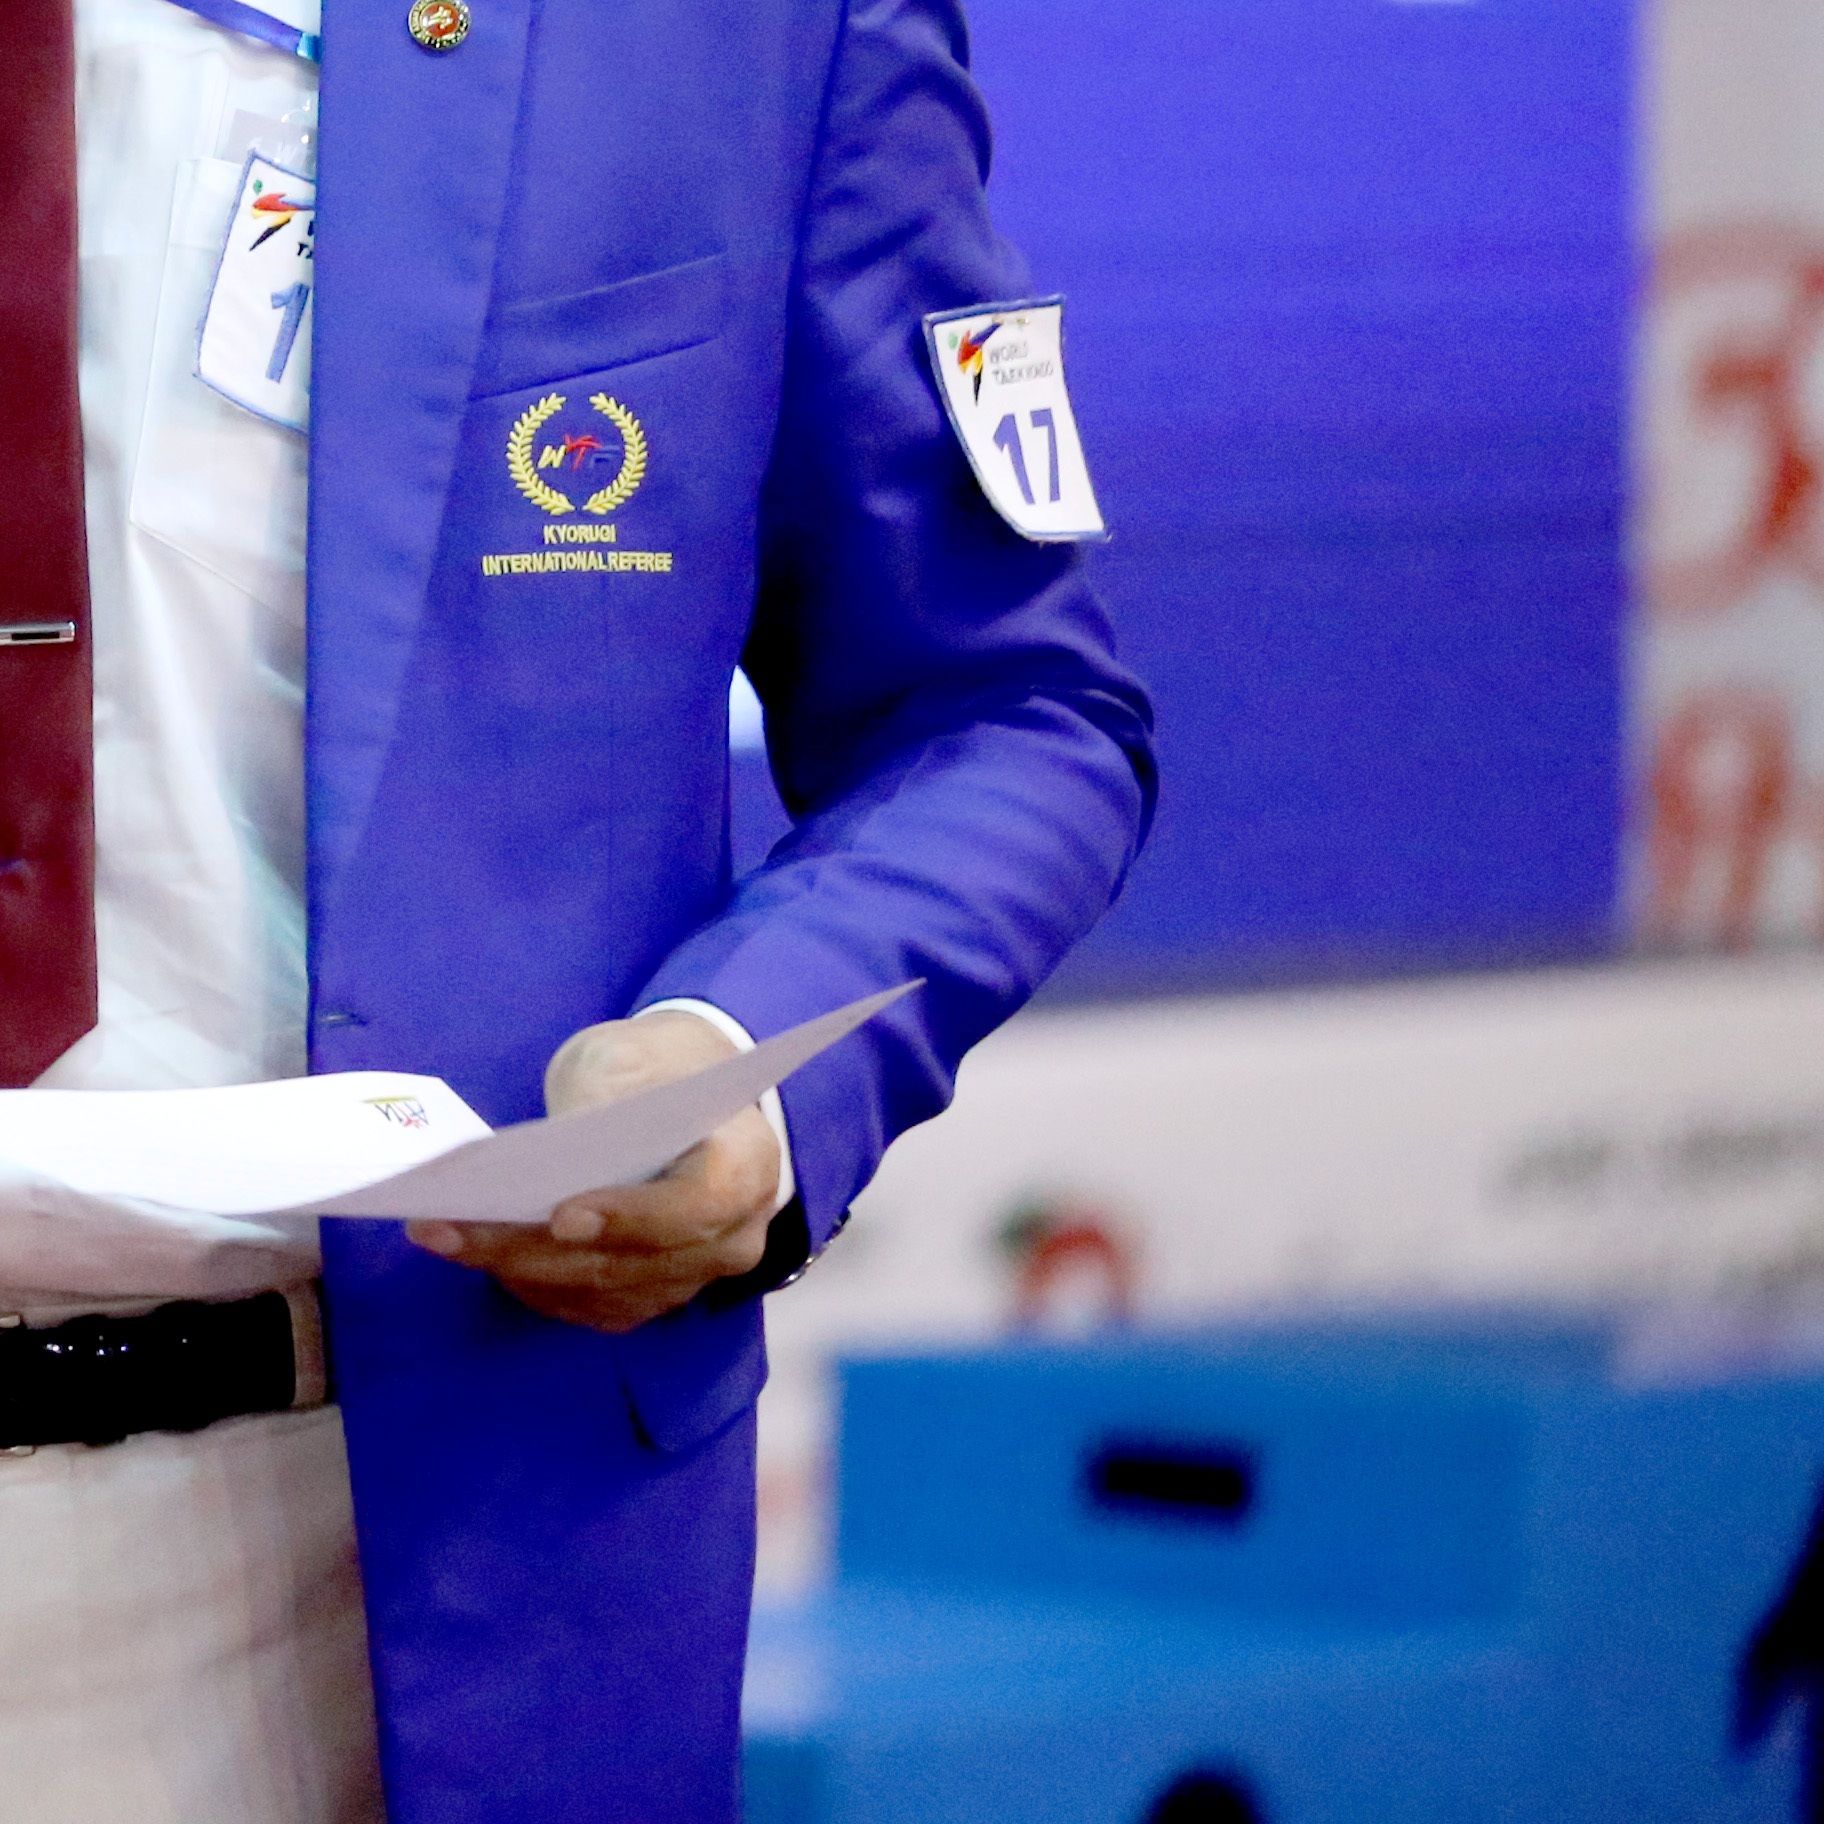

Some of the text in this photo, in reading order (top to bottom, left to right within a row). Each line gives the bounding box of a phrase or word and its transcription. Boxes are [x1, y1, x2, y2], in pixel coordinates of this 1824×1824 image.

[265, 281, 311, 384] 1
[993, 407, 1061, 506] 17
[482, 551, 673, 576] INTERNATIONAL REFEREE
[543, 524, 617, 544] KYORUGI
